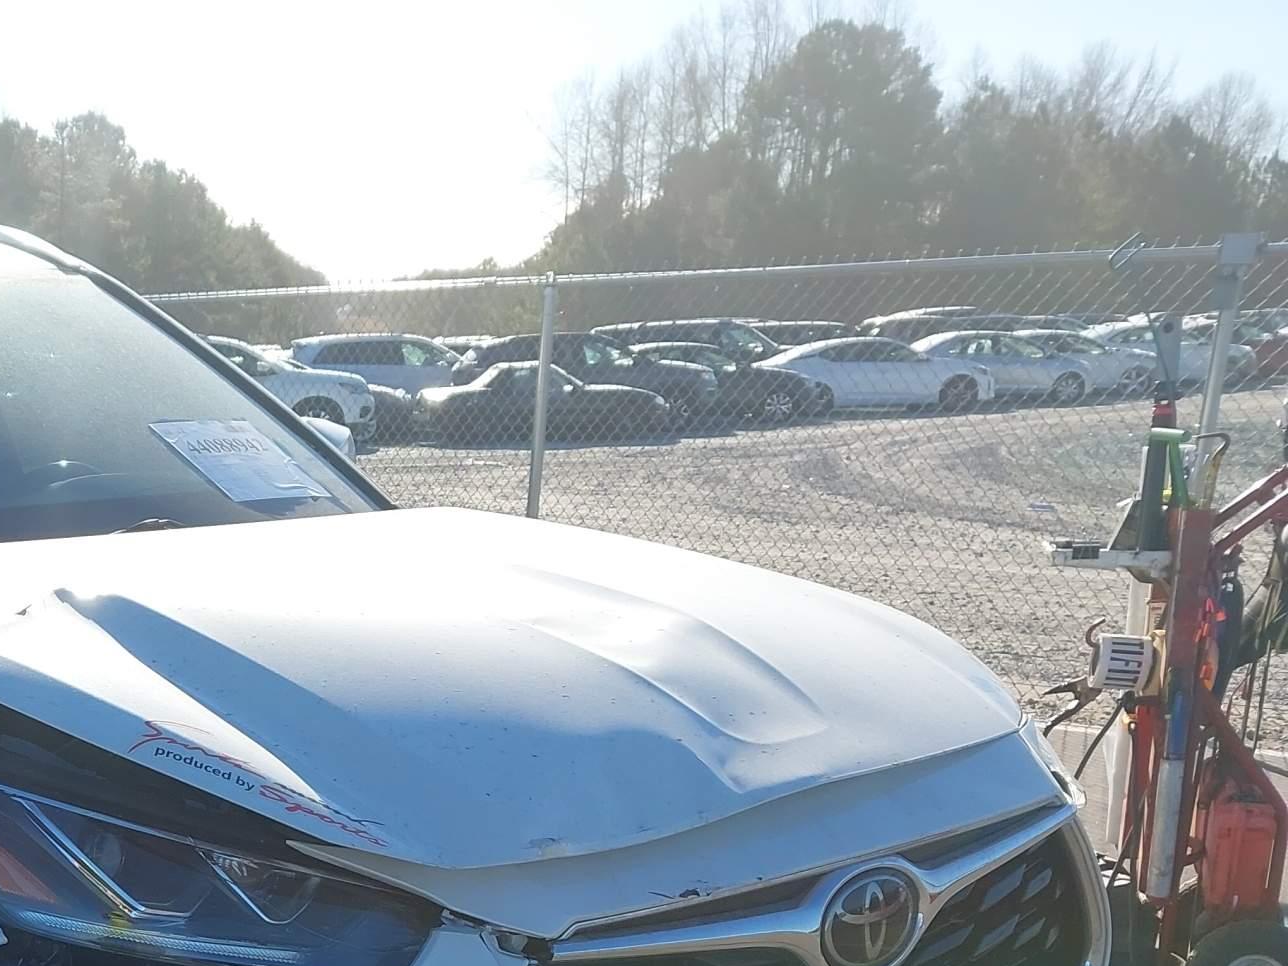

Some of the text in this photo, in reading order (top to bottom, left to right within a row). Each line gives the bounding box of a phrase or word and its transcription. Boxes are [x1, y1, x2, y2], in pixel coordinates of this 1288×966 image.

[186, 438, 269, 455] 44088942
[154, 746, 232, 782] produced
[235, 774, 255, 793] by
[259, 784, 389, 847] Sports
